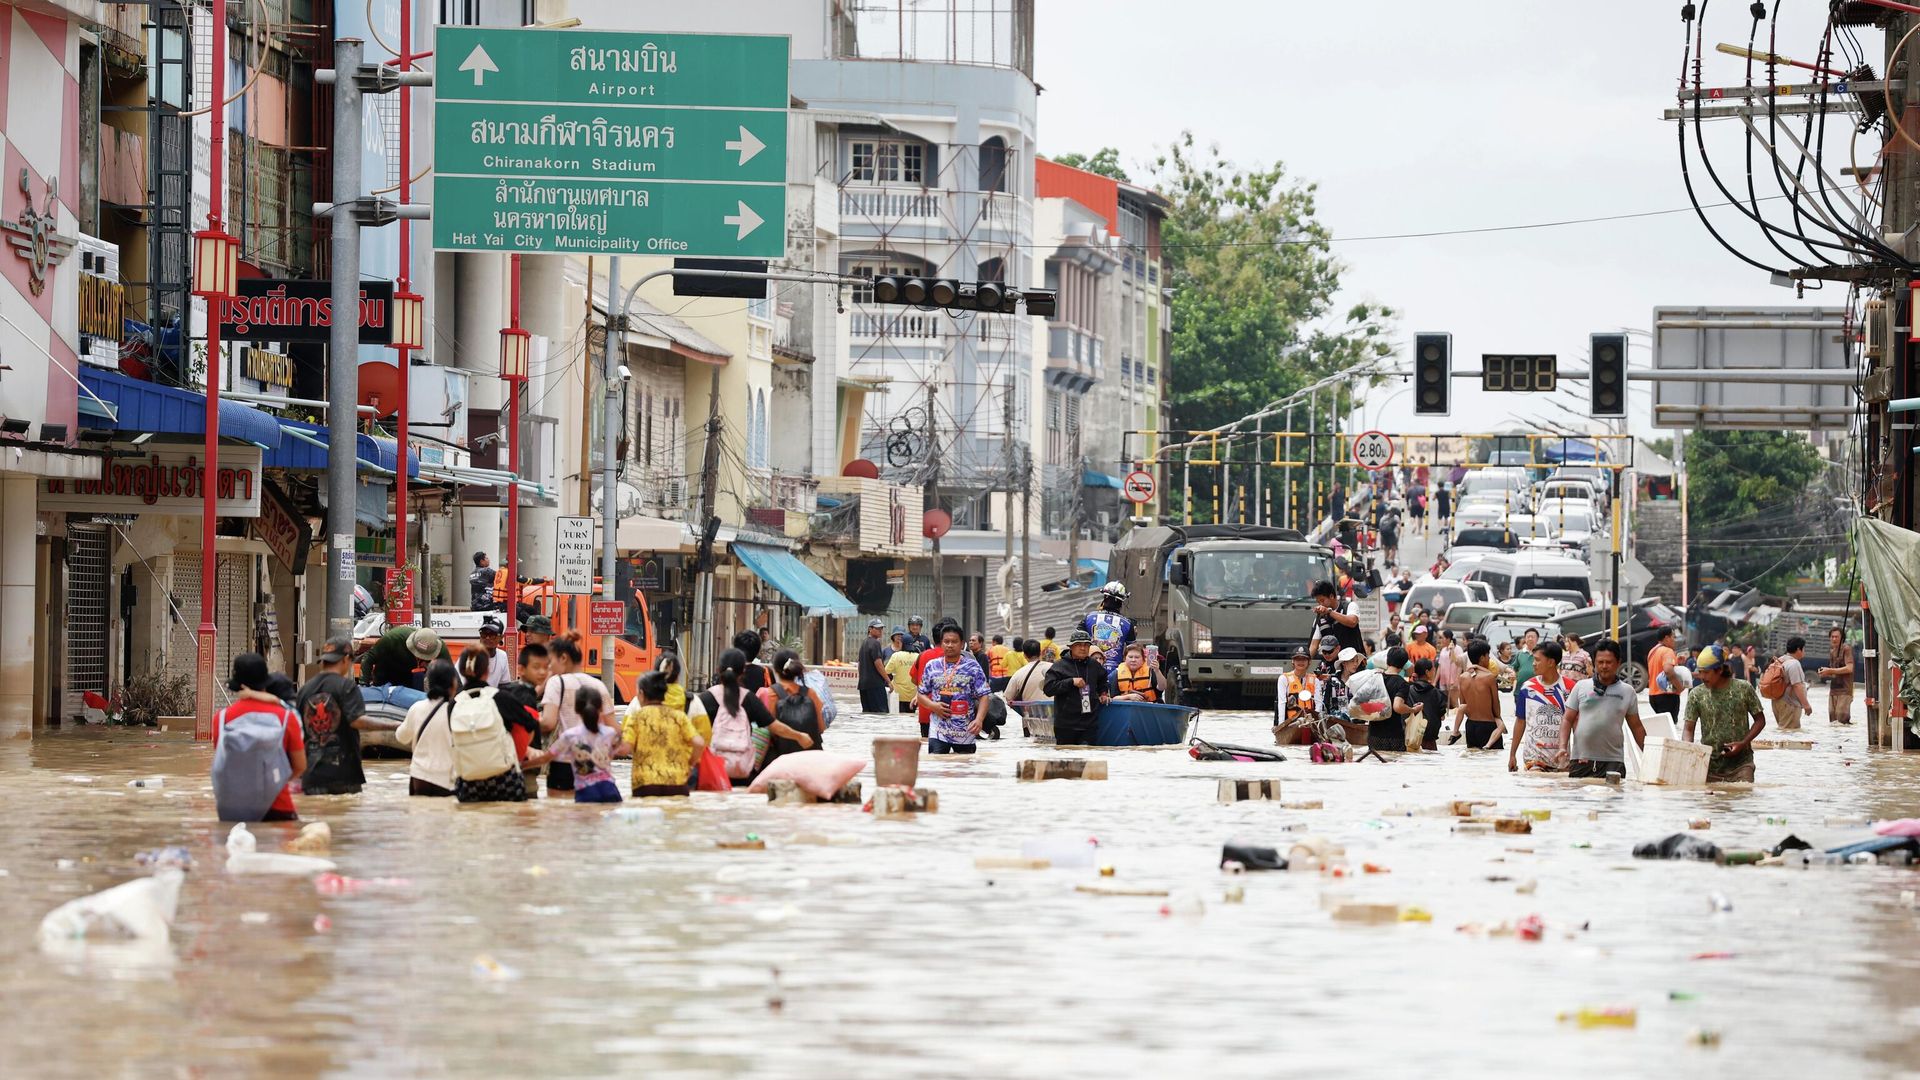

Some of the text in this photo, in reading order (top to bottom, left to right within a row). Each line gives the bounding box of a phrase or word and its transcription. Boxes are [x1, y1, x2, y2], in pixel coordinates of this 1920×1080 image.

[570, 42, 677, 74] สนามบิน
[588, 82, 656, 97] Airport
[1713, 89, 1720, 98] A
[1837, 84, 1844, 92] C
[471, 114, 675, 149] สนามกีฬาจิรนคร
[483, 155, 656, 172] Chiranakorn Stadium
[495, 178, 649, 207] สำนักงานเทศบาล
[493, 207, 608, 235] นครหาดใหญ่
[452, 232, 688, 251] Hat Yai City Municipality Office
[563, 530, 588, 539] TURN
